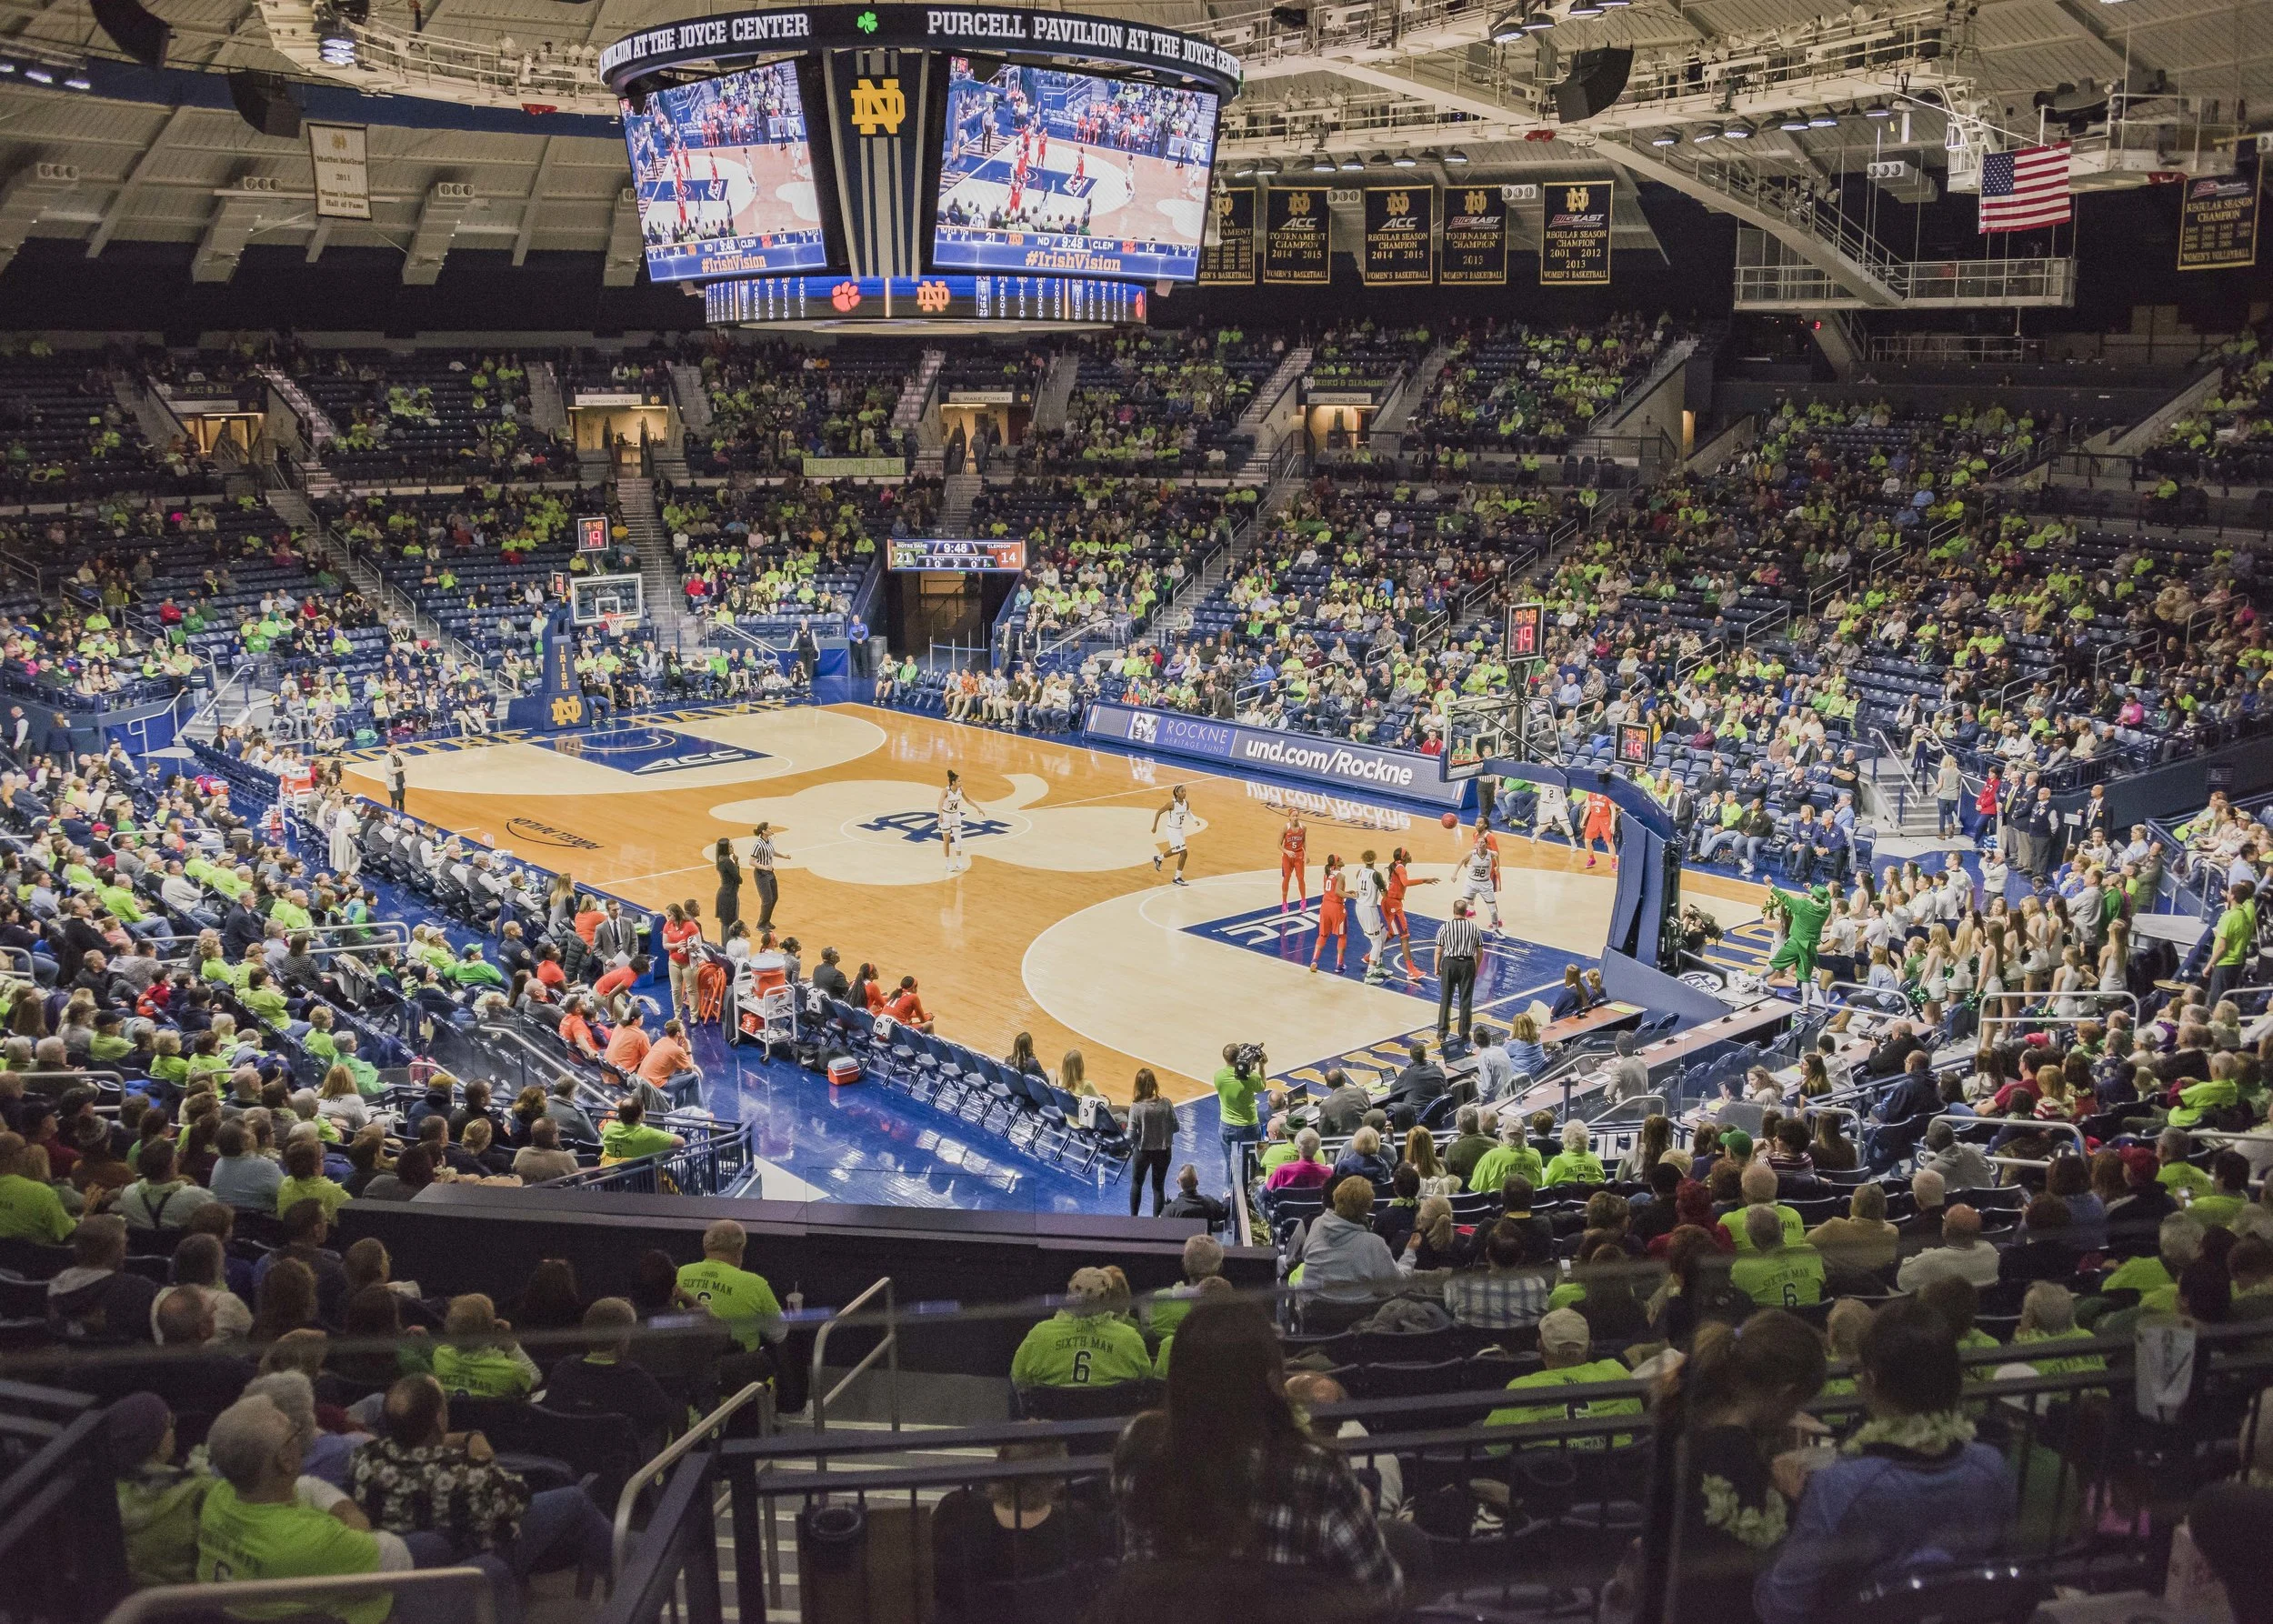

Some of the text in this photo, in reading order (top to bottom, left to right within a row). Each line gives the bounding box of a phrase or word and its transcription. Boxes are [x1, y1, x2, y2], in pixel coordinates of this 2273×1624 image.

[633, 13, 810, 58] AT THE JOYCE CENTER
[926, 11, 1215, 66] PURCELL PAVILION AT THE JOYCE
[852, 79, 906, 134] ND
[2187, 202, 2221, 213] REGULAR
[2198, 210, 2240, 223] CHAMPION
[1281, 217, 1318, 228] ACC
[1381, 217, 1417, 228] ACC
[1269, 232, 1327, 241] TOURNAMENT
[1367, 234, 1400, 242] REGULAR
[1446, 232, 1503, 240] TOURNAMENT
[1546, 230, 1607, 239] REGULAR SEASON
[704, 245, 713, 253] ND
[719, 239, 736, 252] 9:48
[740, 238, 756, 249] CLEM
[778, 236, 787, 245] 14
[985, 233, 996, 243] 21
[1037, 236, 1050, 246] ND
[1061, 237, 1084, 250] 9:48
[1093, 240, 1114, 251] CLEM
[1146, 243, 1156, 254] 14
[1275, 241, 1318, 249] CHAMPION
[1378, 241, 1417, 249] CHAMPION
[1453, 241, 1496, 249] CHAMPION
[1557, 239, 1596, 247] CHAMPION
[1272, 249, 1322, 259] 2014 2015
[1371, 250, 1424, 259] 2014 2015
[1549, 249, 1601, 258] 2001 2012
[701, 253, 767, 274] #IrishVision
[1025, 250, 1122, 272] #IrishVision
[1462, 256, 1484, 265] 2013
[1566, 259, 1586, 268] 2013
[1293, 270, 1327, 278] BASKETBALL
[1395, 271, 1428, 279] BASKETBALL
[1470, 271, 1503, 279] BASKETBALL
[1571, 270, 1607, 278] BASKETBALL
[916, 280, 951, 312] ND
[978, 308, 987, 316] 22
[588, 531, 601, 545] 19
[943, 543, 967, 554] 9:48
[896, 552, 911, 563] 21
[1001, 552, 1017, 563] 14
[935, 560, 977, 568] 0 2 0
[1517, 626, 1533, 652] 19
[559, 644, 569, 690] IRISH
[551, 696, 582, 726] ND
[1167, 720, 1228, 744] ROCKNE
[1164, 737, 1225, 754] HERITAGE FUND
[1628, 742, 1642, 757] 19
[638, 747, 746, 772] ACC
[1246, 738, 1414, 786] und.com/Rockne
[1548, 789, 1554, 798] 2
[949, 802, 958, 811] 14
[1291, 841, 1297, 849] 5
[1326, 879, 1331, 892] 0
[1360, 880, 1367, 891] 11
[614, 1143, 623, 1158] 6
[683, 1278, 709, 1289] SIXTH
[712, 1280, 733, 1296] MAN
[1782, 1282, 1797, 1307] 6
[1055, 1336, 1114, 1354] SIXTH MAN
[1072, 1350, 1092, 1383] 6
